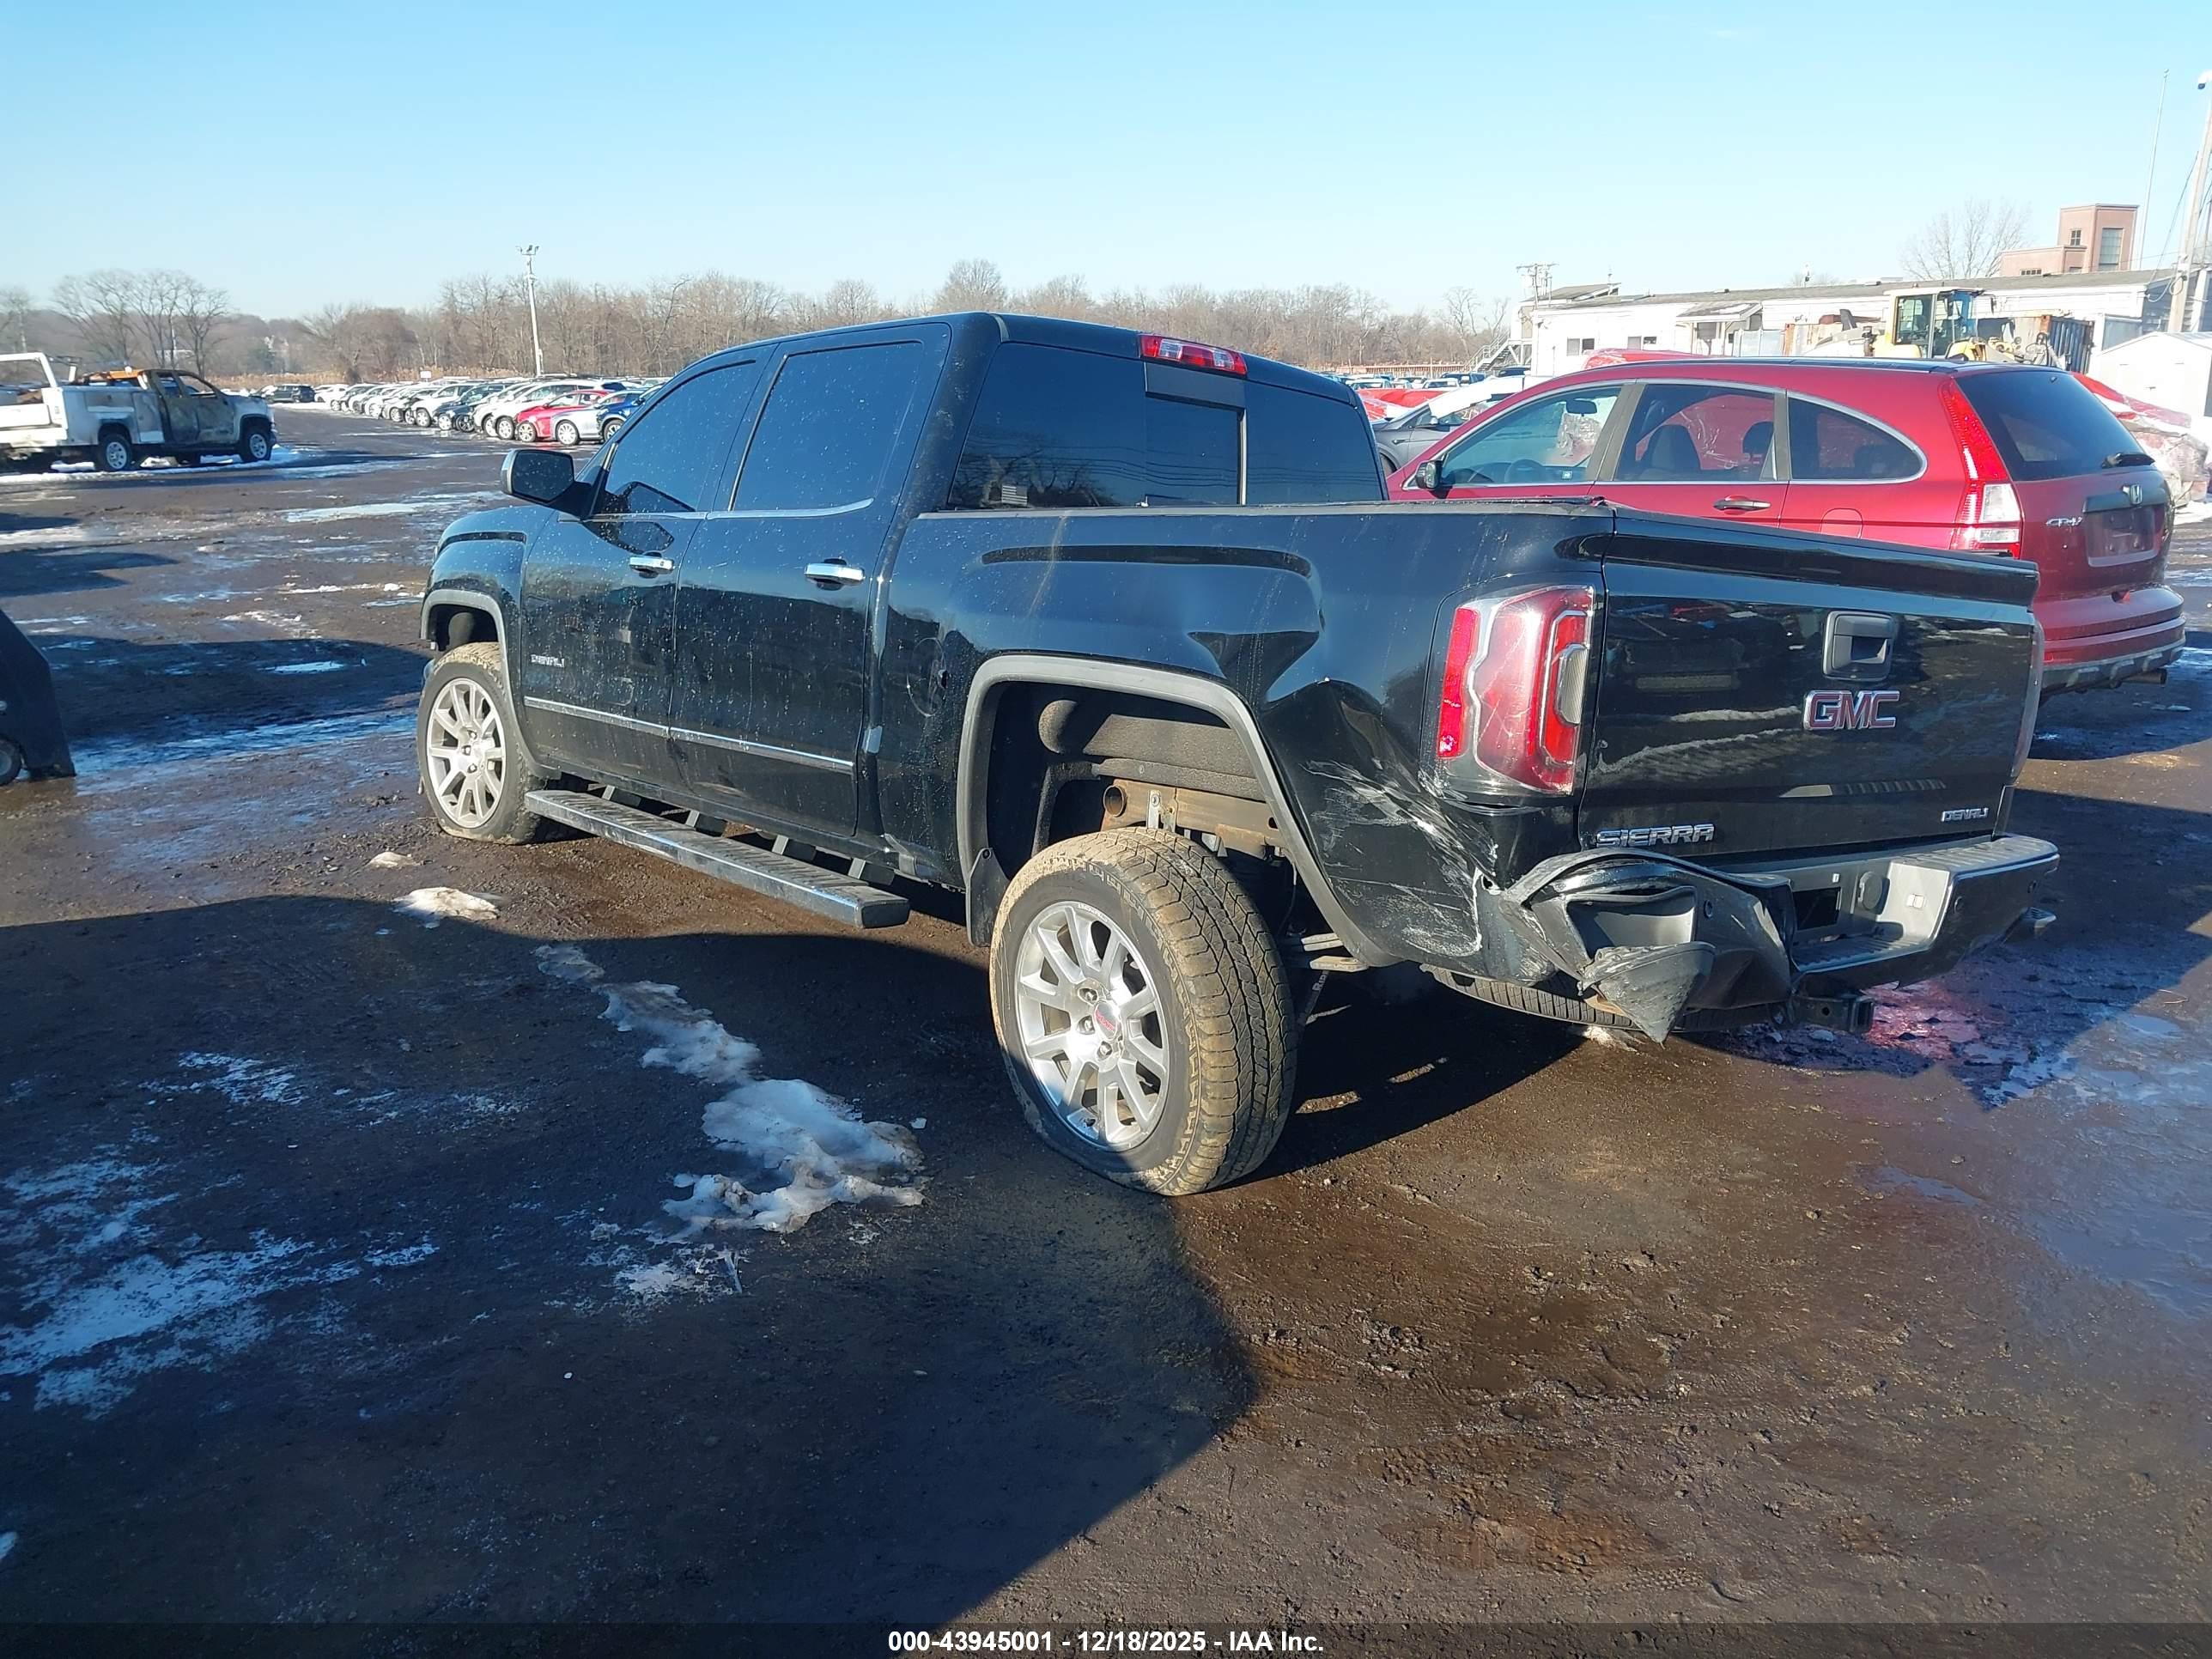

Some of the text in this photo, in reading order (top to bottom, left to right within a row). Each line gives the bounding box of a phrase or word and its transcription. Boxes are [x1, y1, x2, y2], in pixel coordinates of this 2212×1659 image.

[530, 653, 565, 668] DENALI
[1803, 690, 1900, 731] GMC
[1941, 807, 1989, 823] DENALI
[1596, 823, 1715, 848] SIERRA
